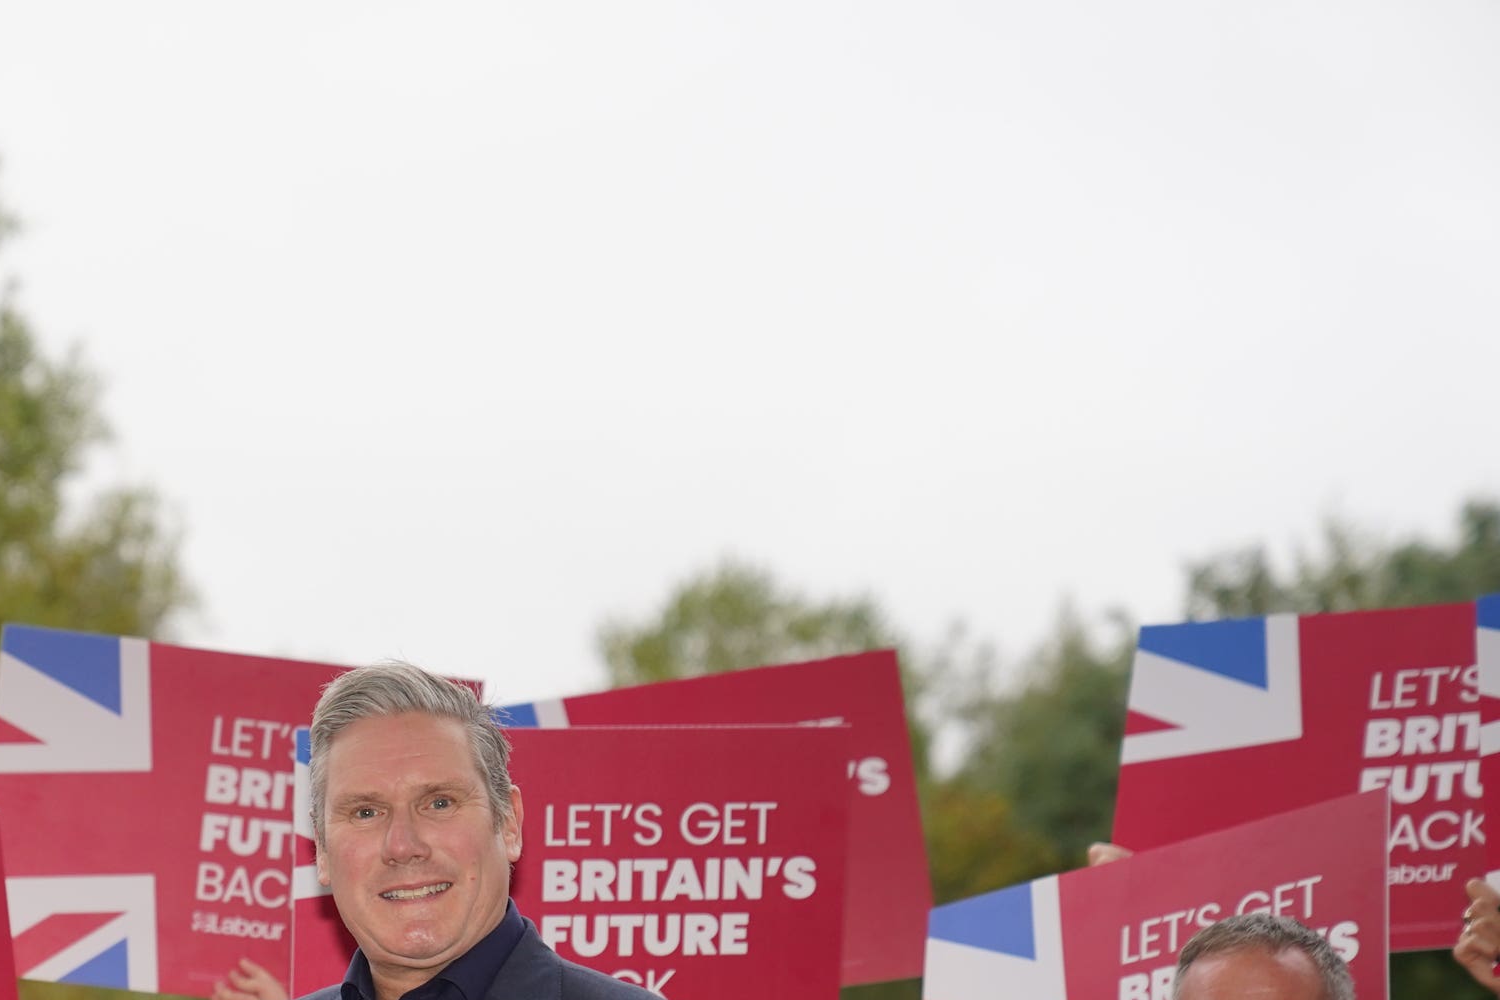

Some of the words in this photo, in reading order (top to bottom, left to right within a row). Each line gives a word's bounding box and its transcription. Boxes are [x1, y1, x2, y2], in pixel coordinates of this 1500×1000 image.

[200, 812, 295, 860] FUT
[544, 803, 663, 847] LET'S
[679, 802, 778, 845] GET
[1388, 809, 1485, 853] ACK
[196, 861, 293, 910] BAC
[541, 856, 817, 902] BRITAIN'S
[1387, 863, 1457, 885] abour
[211, 916, 286, 941] Labour
[541, 912, 750, 957] FUTURE
